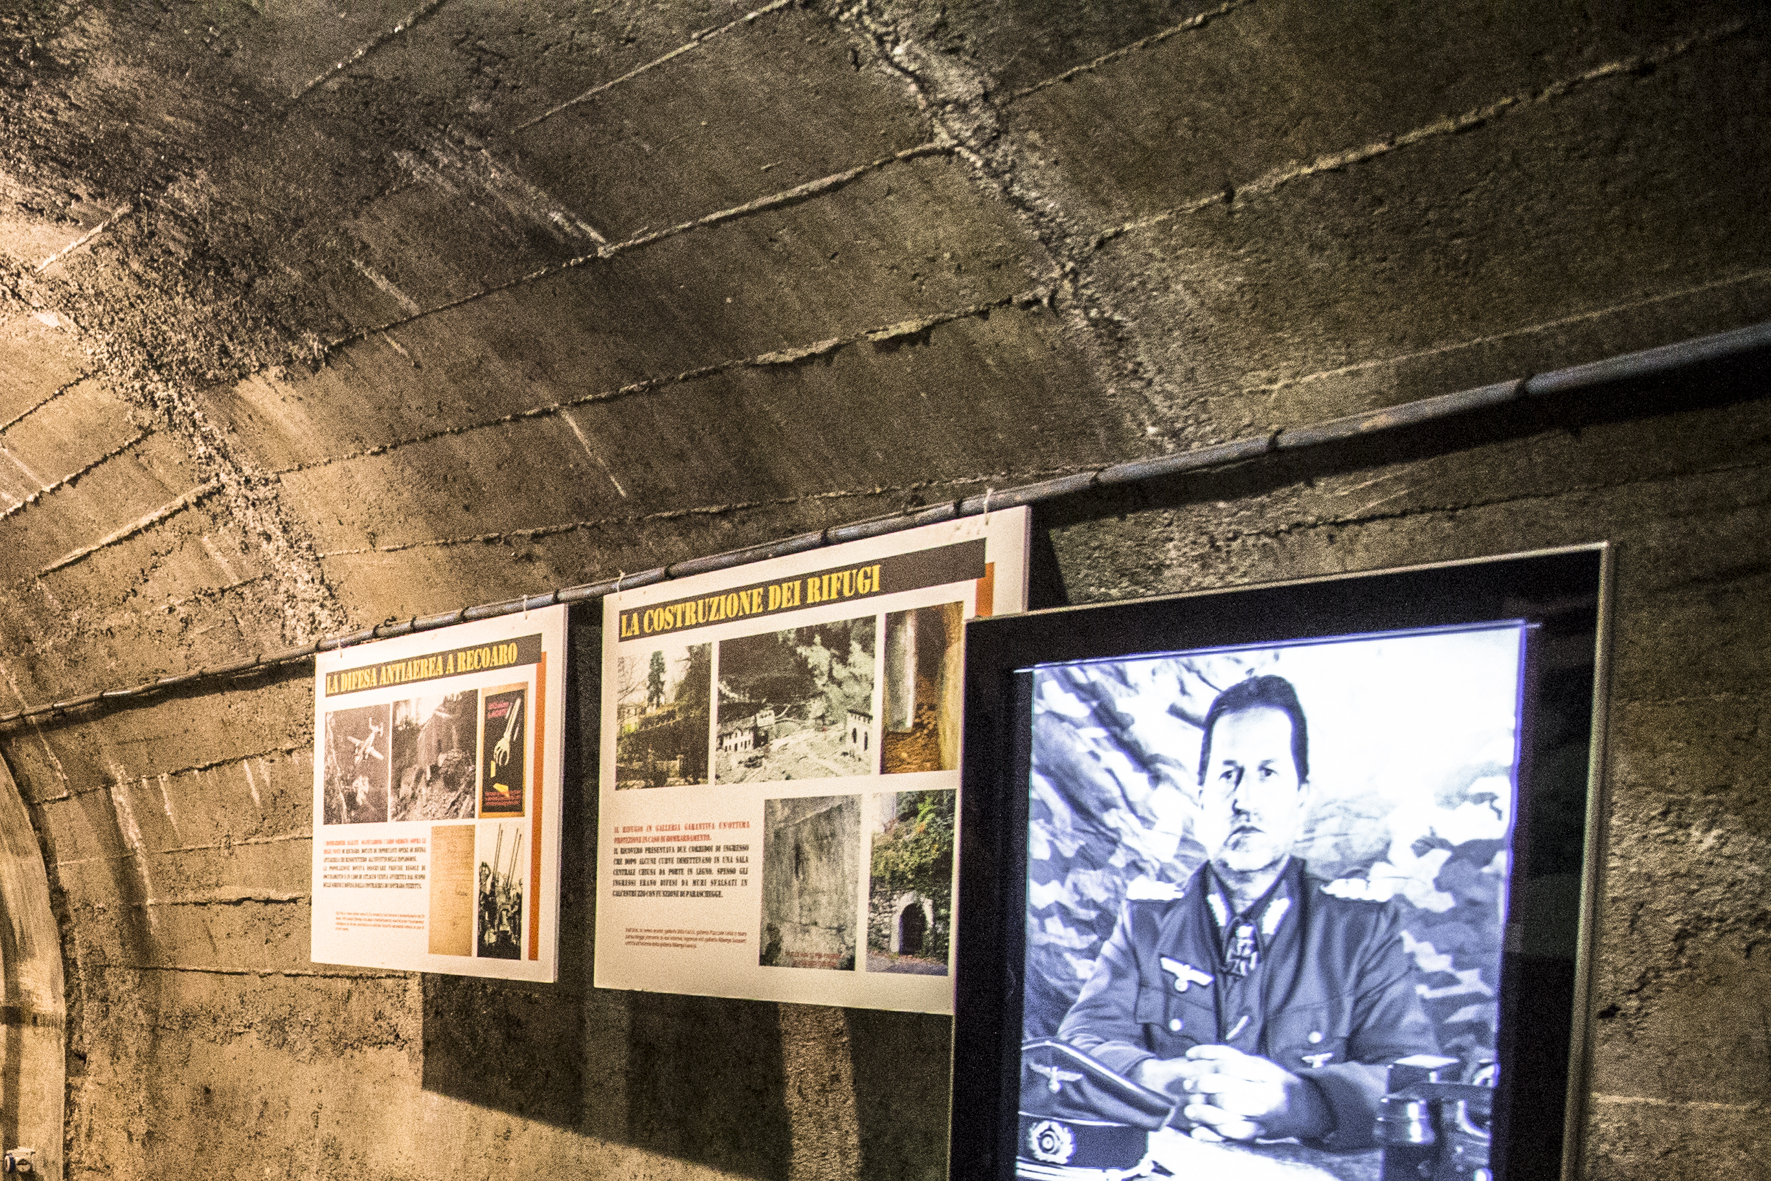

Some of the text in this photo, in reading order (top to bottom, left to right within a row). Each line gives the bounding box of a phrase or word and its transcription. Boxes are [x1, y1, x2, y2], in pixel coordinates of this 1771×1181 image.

[620, 564, 881, 639] LA COSTRUZIONE DEI RIFUGI
[326, 642, 518, 695] LA DIFESA ANTIAEREA A RECOARO
